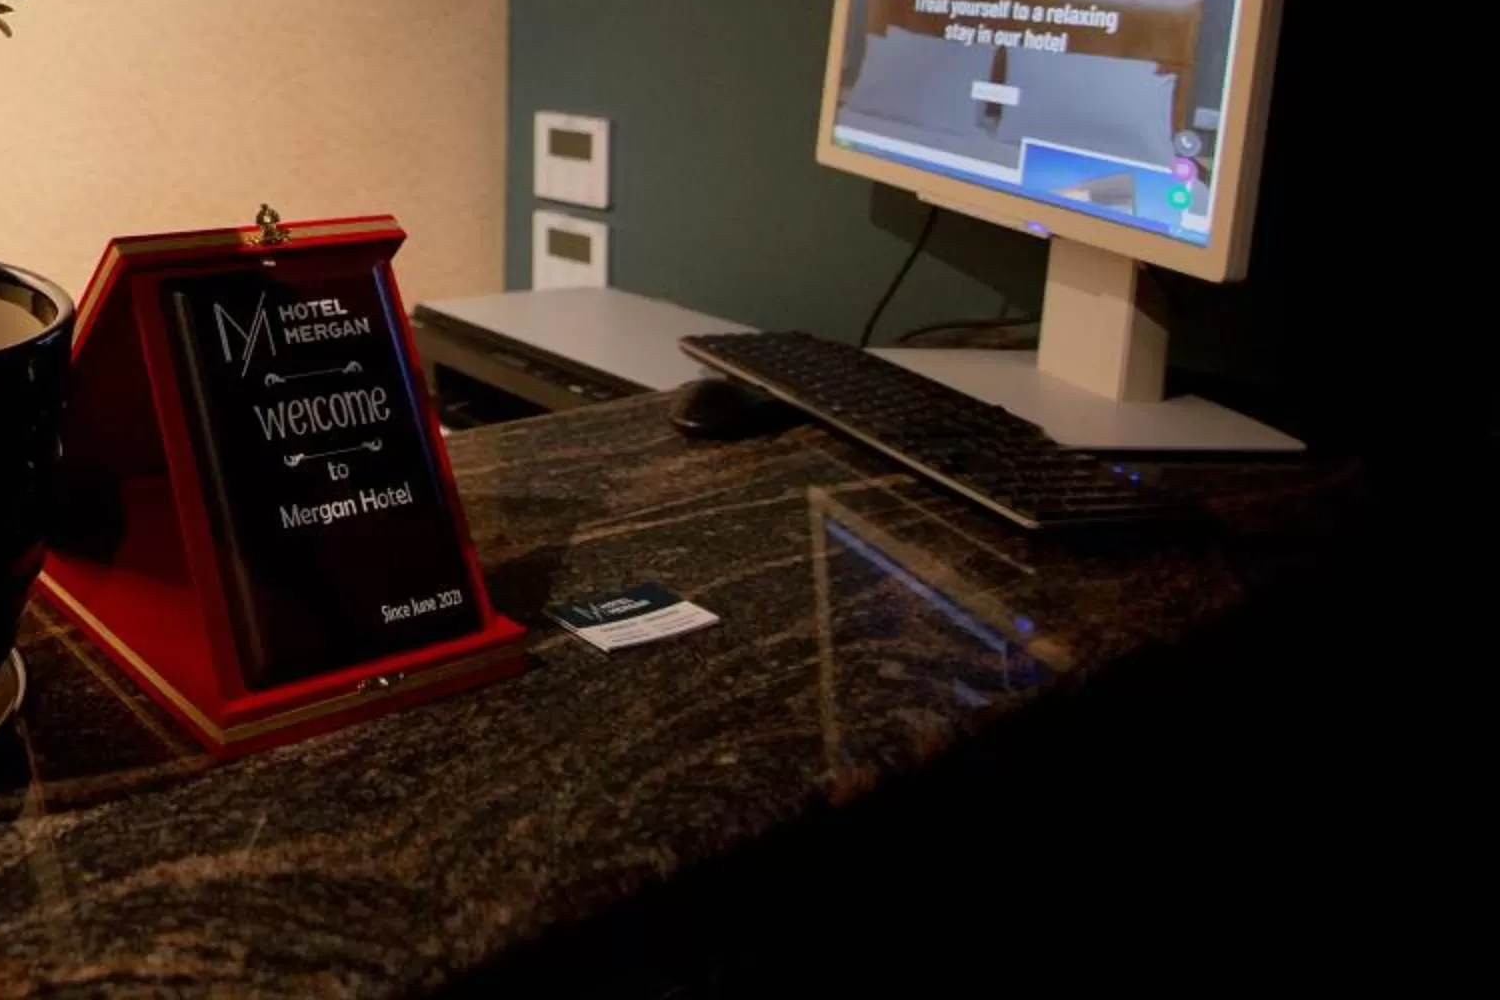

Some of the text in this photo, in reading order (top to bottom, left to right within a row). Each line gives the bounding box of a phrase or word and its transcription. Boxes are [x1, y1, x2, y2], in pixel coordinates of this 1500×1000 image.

[1012, 1, 1030, 20] to
[1031, 5, 1045, 23] a
[1045, 3, 1120, 34] relaxing
[944, 23, 1069, 53] stay in our hotel
[278, 298, 348, 323] HOTEL
[283, 316, 371, 345] MERGAN
[327, 461, 350, 481] to
[279, 481, 413, 529] Mergan Hotel
[380, 588, 463, 624] Since June 2021
